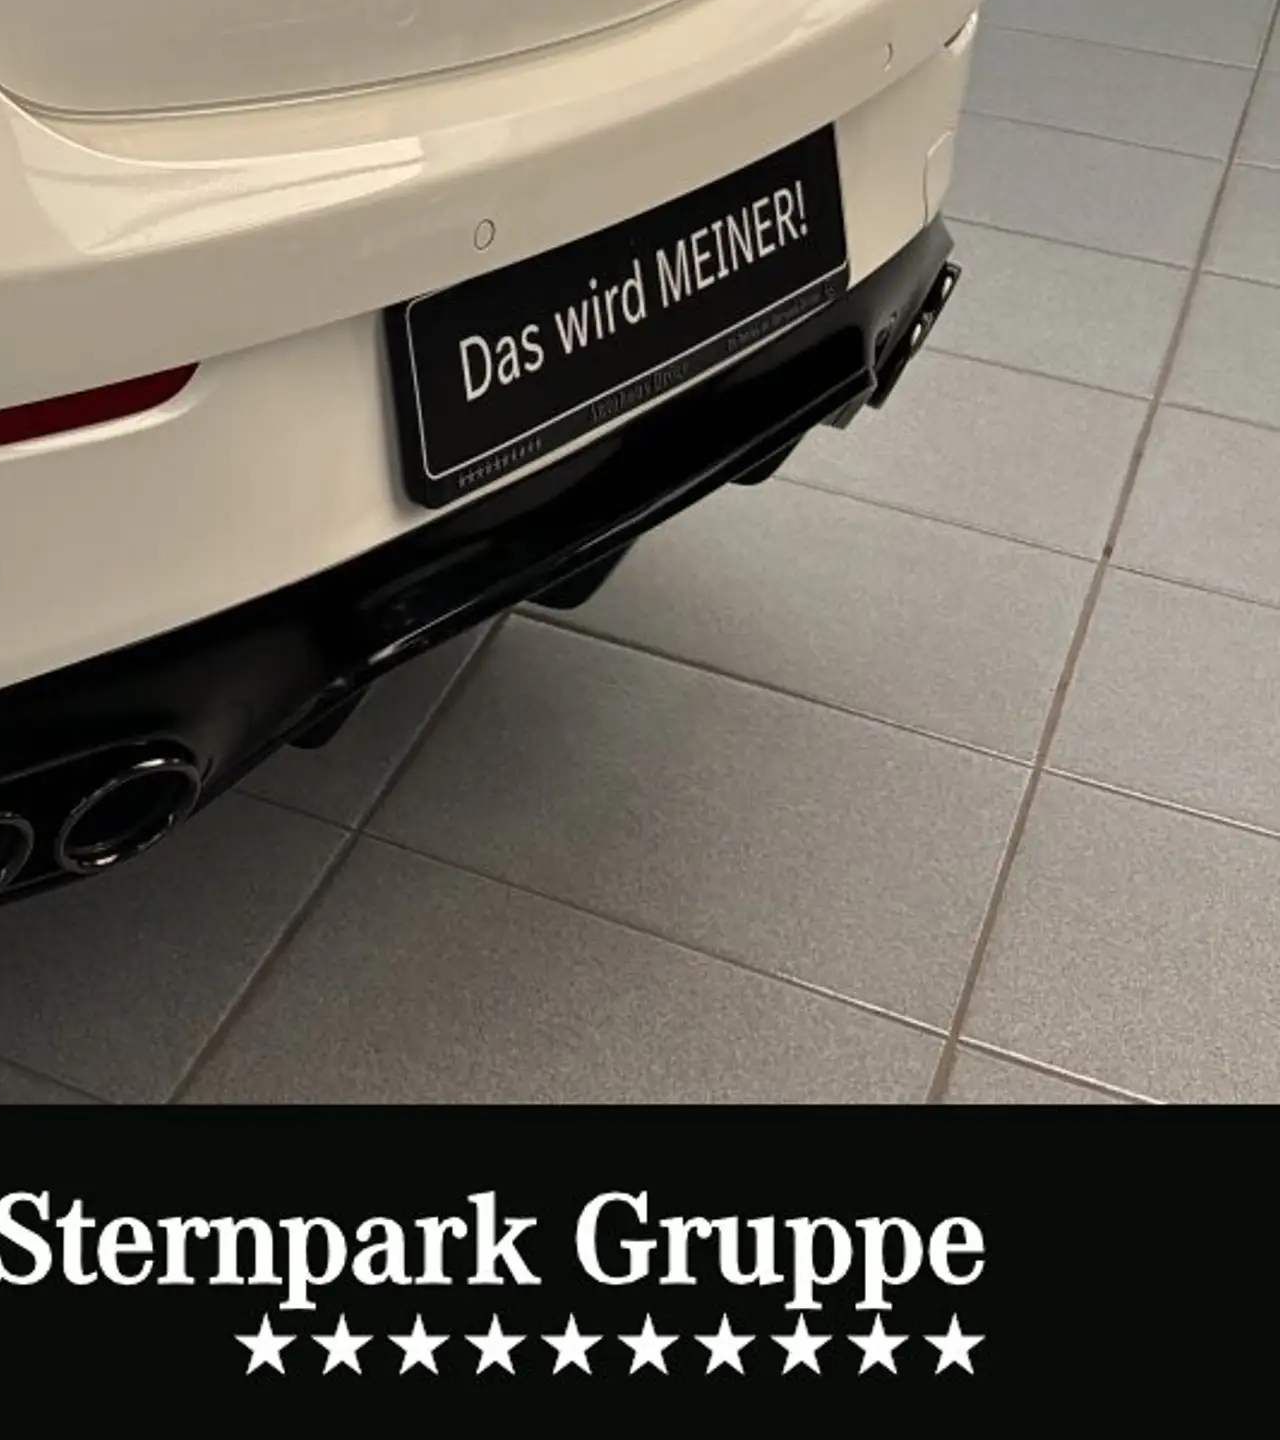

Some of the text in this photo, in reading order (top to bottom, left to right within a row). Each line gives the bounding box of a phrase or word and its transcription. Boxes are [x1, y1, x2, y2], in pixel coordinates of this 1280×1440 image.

[459, 324, 544, 401] Das
[554, 259, 646, 354] wird
[656, 180, 808, 308] MEINER!
